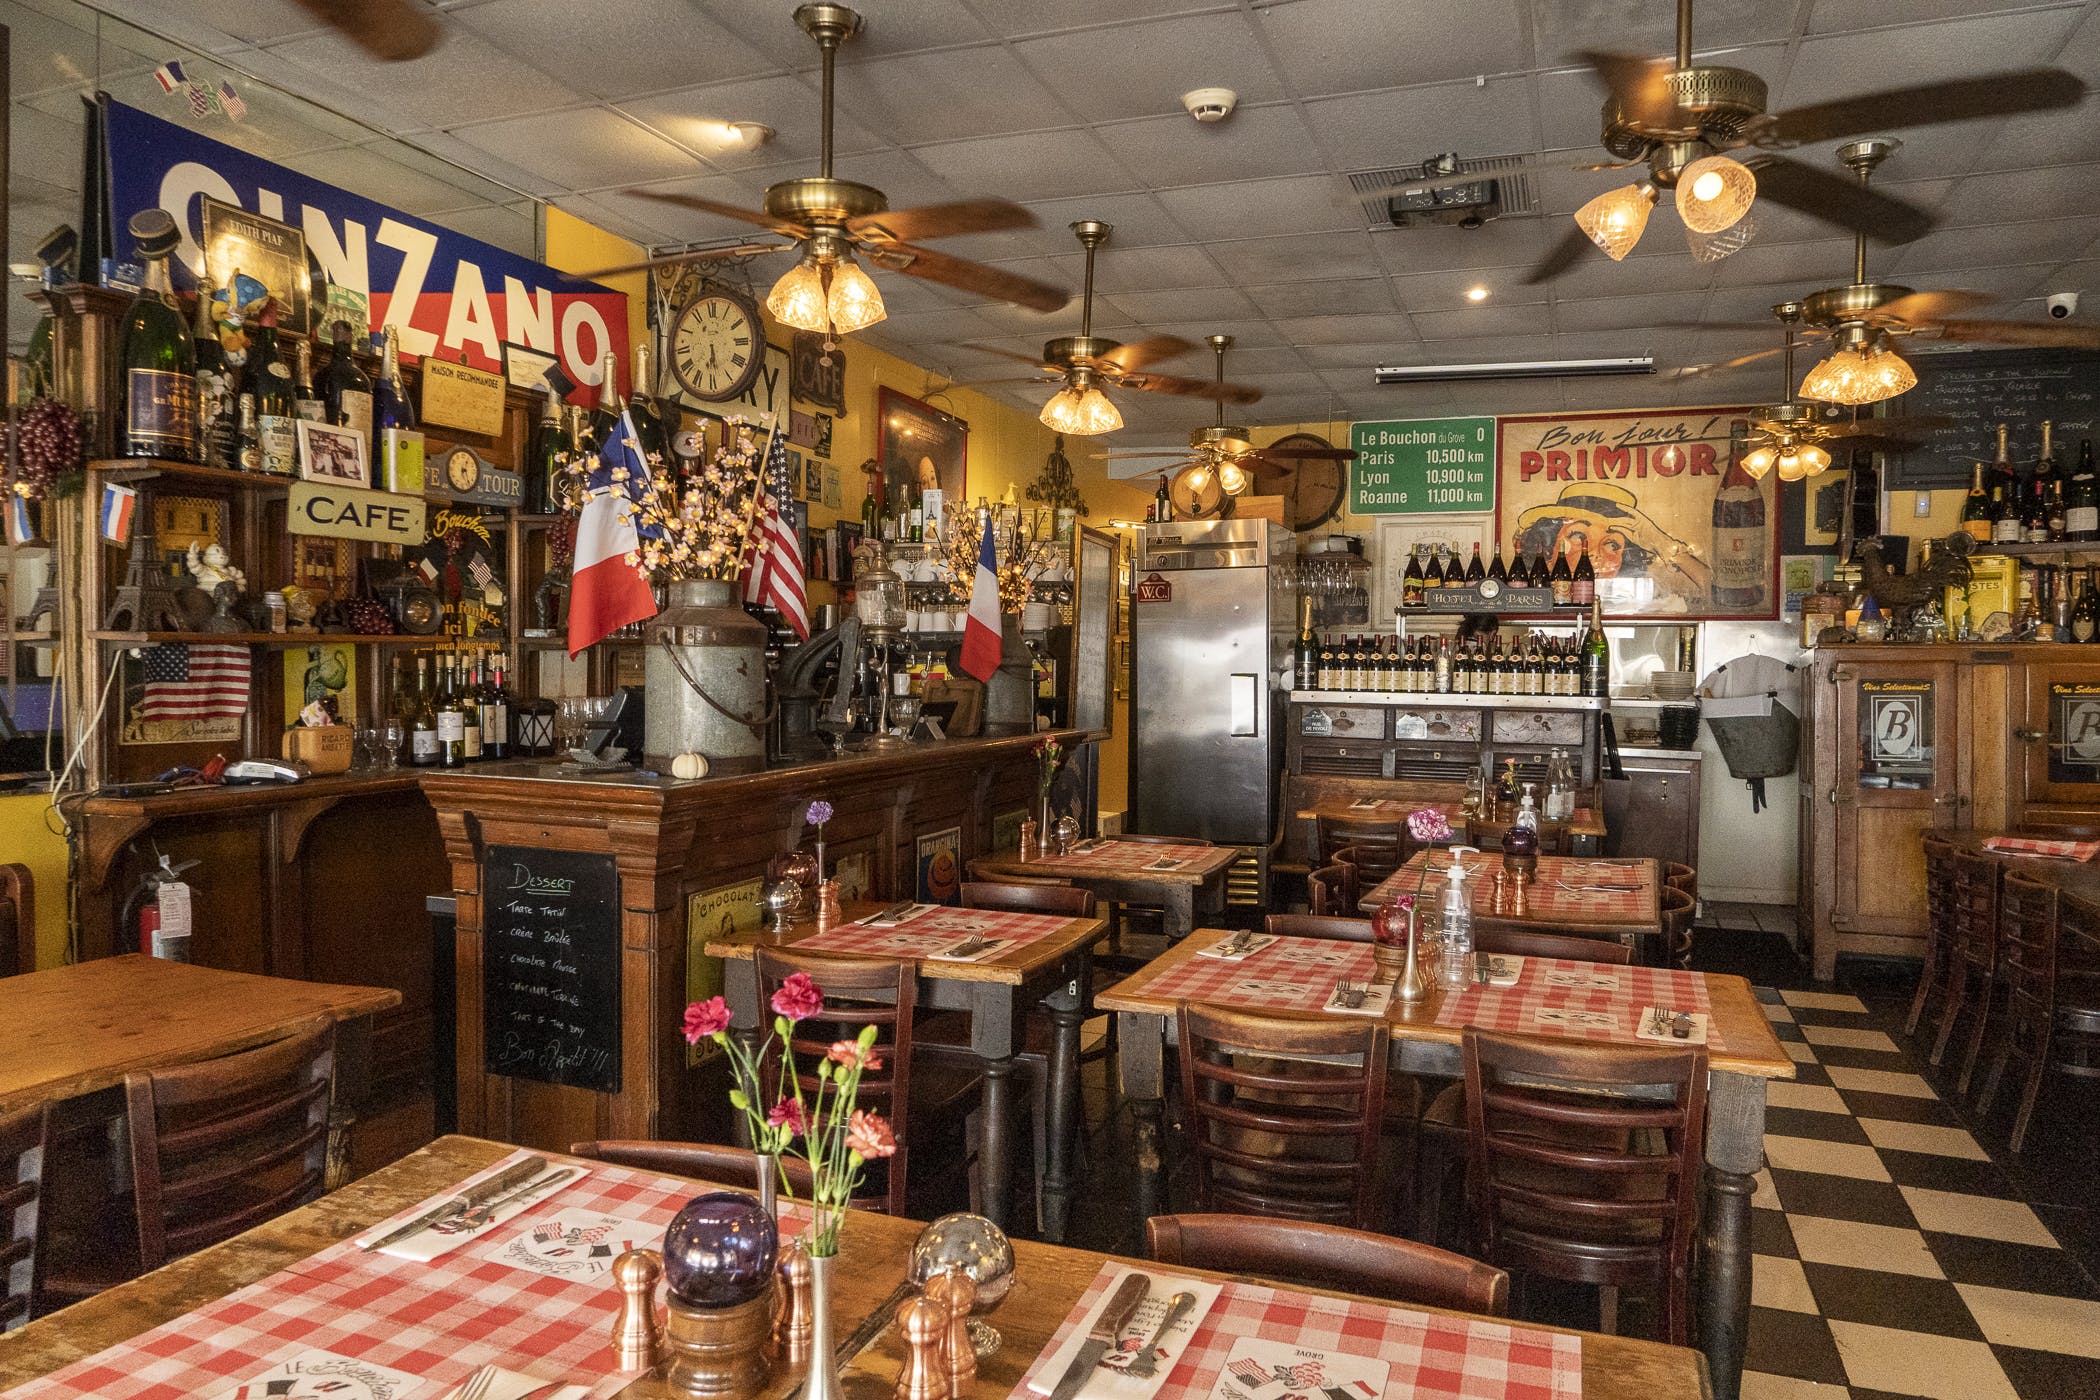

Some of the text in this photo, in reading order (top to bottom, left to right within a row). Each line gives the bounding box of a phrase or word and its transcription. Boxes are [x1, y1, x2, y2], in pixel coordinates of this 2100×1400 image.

[261, 229, 284, 247] PIAF
[159, 162, 611, 387] CNZANO
[1361, 427, 1485, 446] Le Bouchon du Grove 0
[1536, 425, 1607, 450] Bon
[1361, 448, 1484, 465] Paris 10,500 km
[1520, 443, 1720, 482] PRIMIOR
[483, 474, 520, 497] TOUR
[1360, 470, 1390, 487] Lyon
[1426, 468, 1465, 485] 10,900
[1467, 471, 1484, 483] km
[1359, 488, 1483, 505] Roanne 11,000 km
[306, 496, 410, 532] CAFE
[433, 509, 492, 549] Bouchon
[1141, 585, 1168, 599] W.C.
[1505, 593, 1544, 605] PARIS
[458, 600, 501, 627] fondée
[444, 620, 462, 635] ici
[1881, 710, 1911, 740] B
[321, 734, 350, 743] RICARD
[1294, 1349, 1325, 1360] GROVE
[285, 1360, 304, 1375] LE
